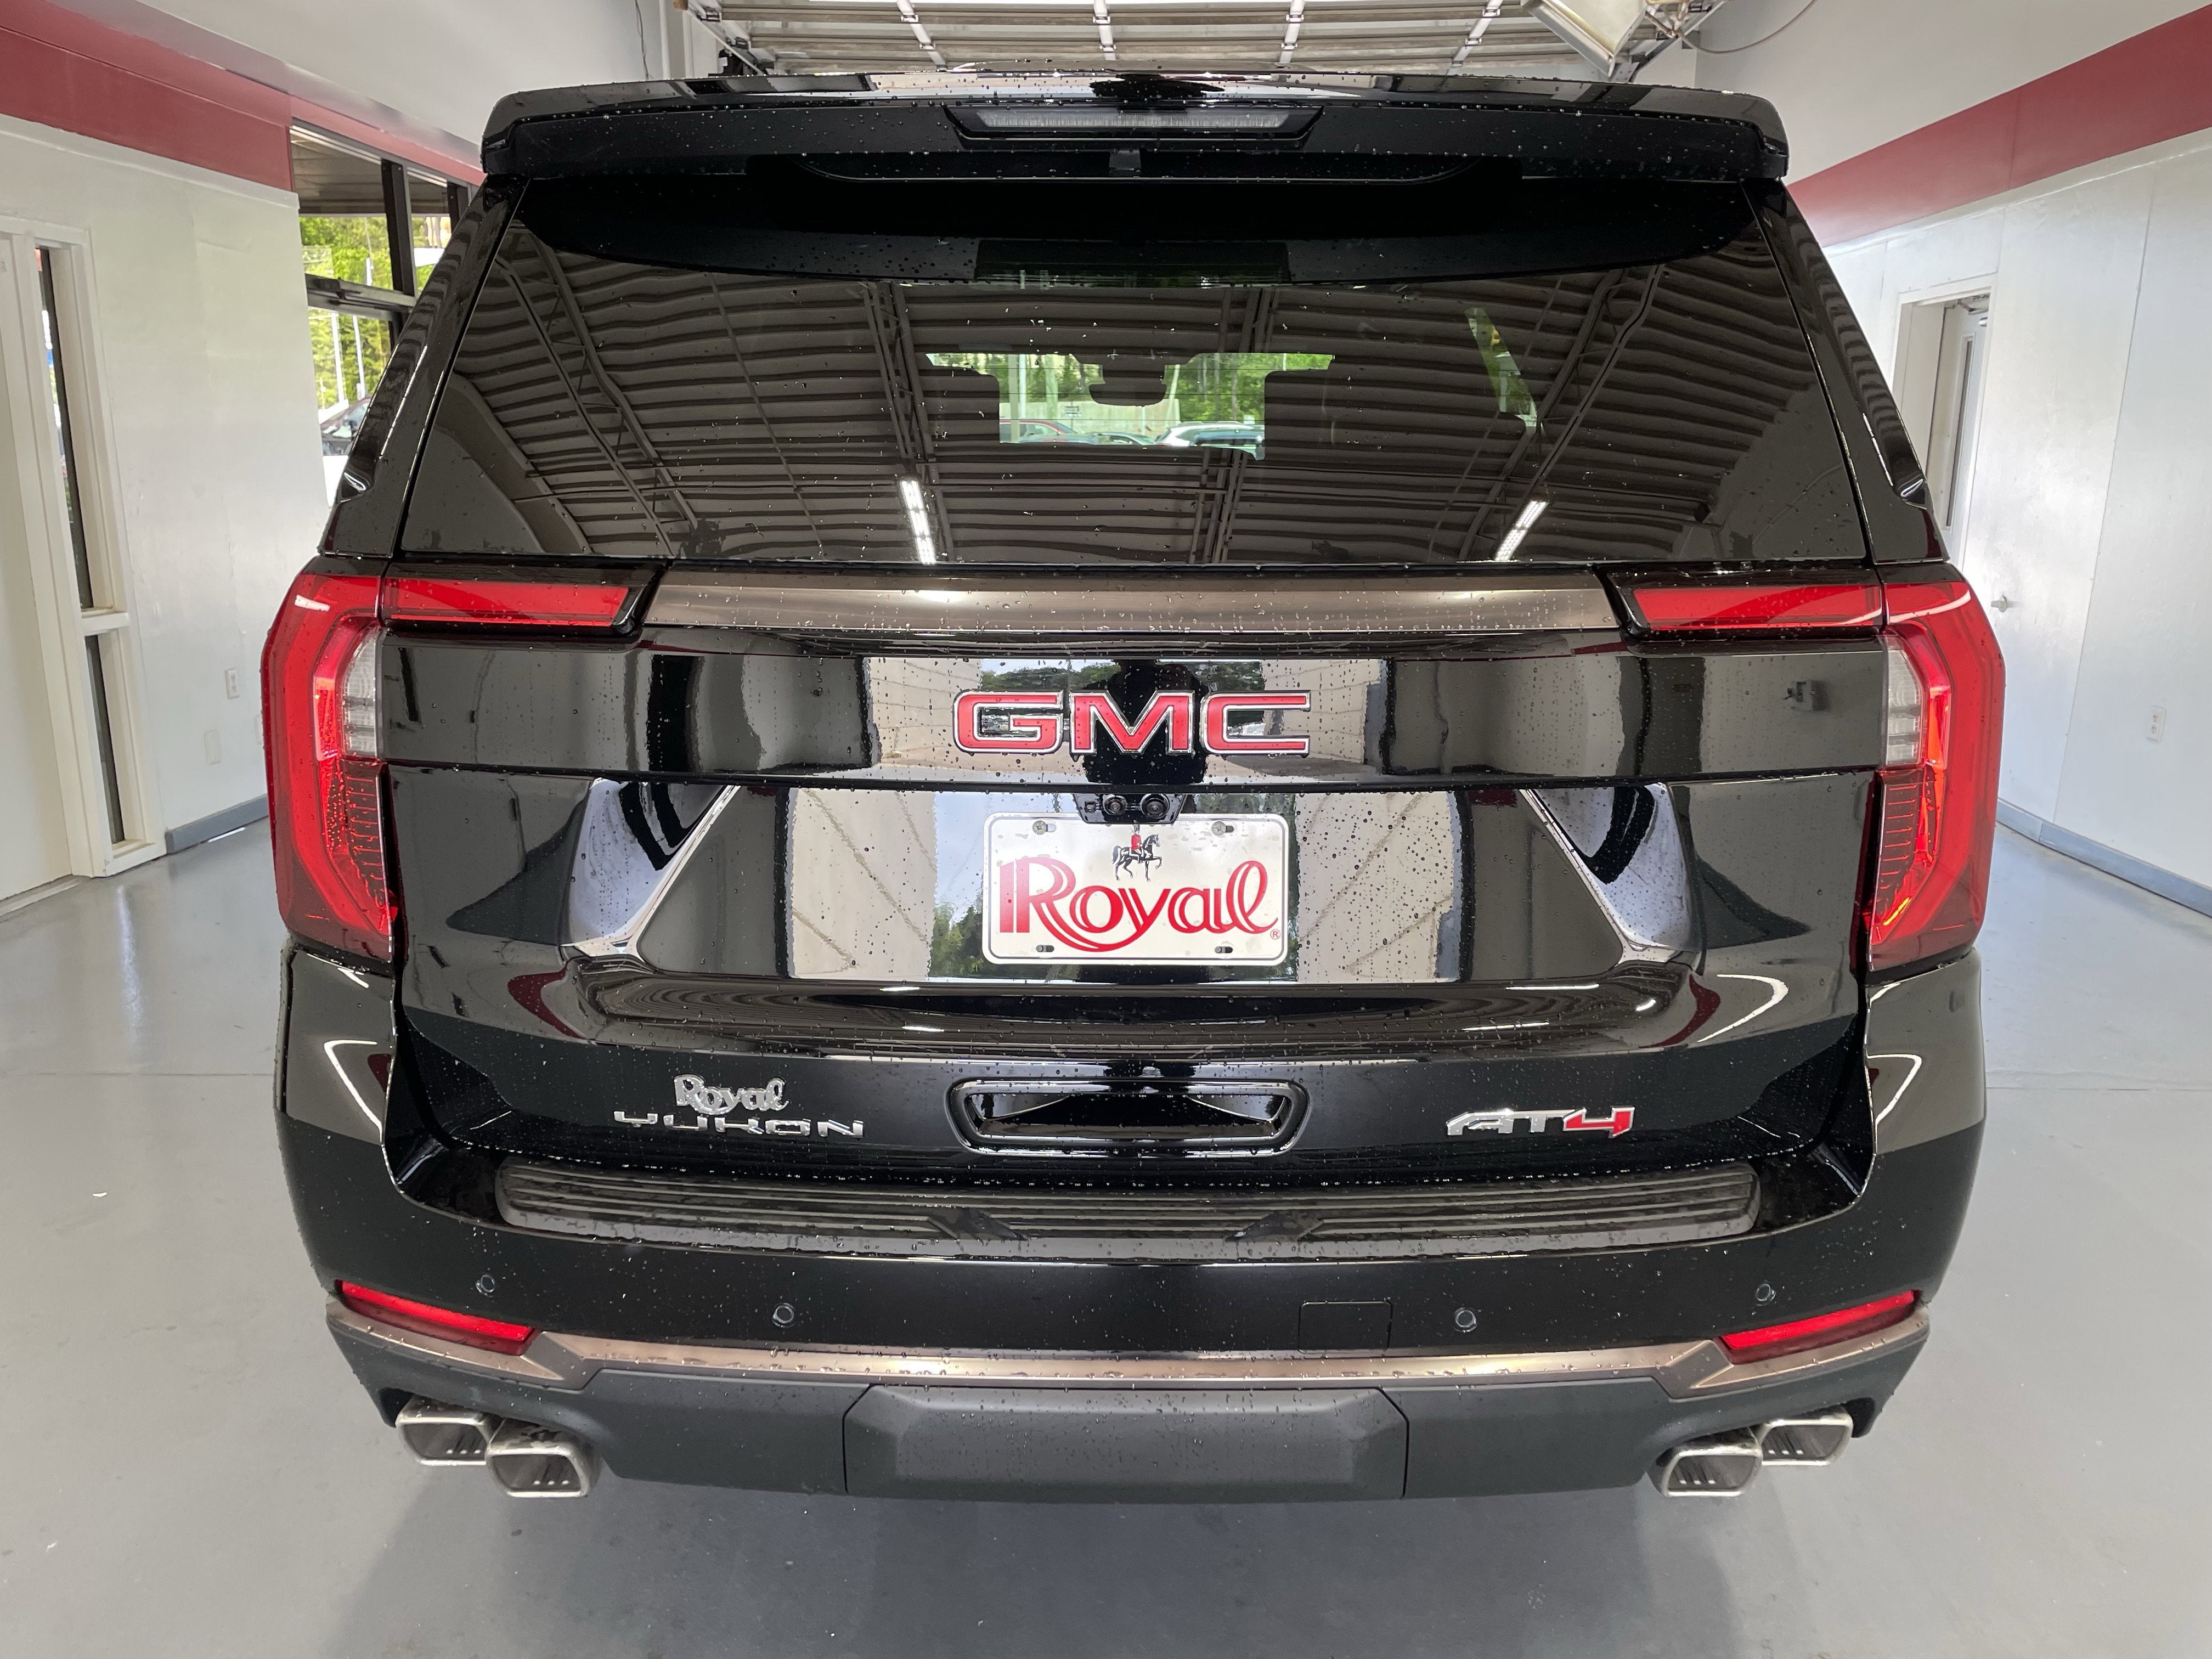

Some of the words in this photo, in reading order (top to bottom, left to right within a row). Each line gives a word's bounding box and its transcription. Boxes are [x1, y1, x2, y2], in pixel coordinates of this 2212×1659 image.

[953, 690, 1312, 755] GMC
[999, 857, 1278, 952] Royal
[674, 1074, 789, 1115] Royal
[613, 1111, 864, 1138] YUKON
[1446, 1105, 1636, 1138] AT4
